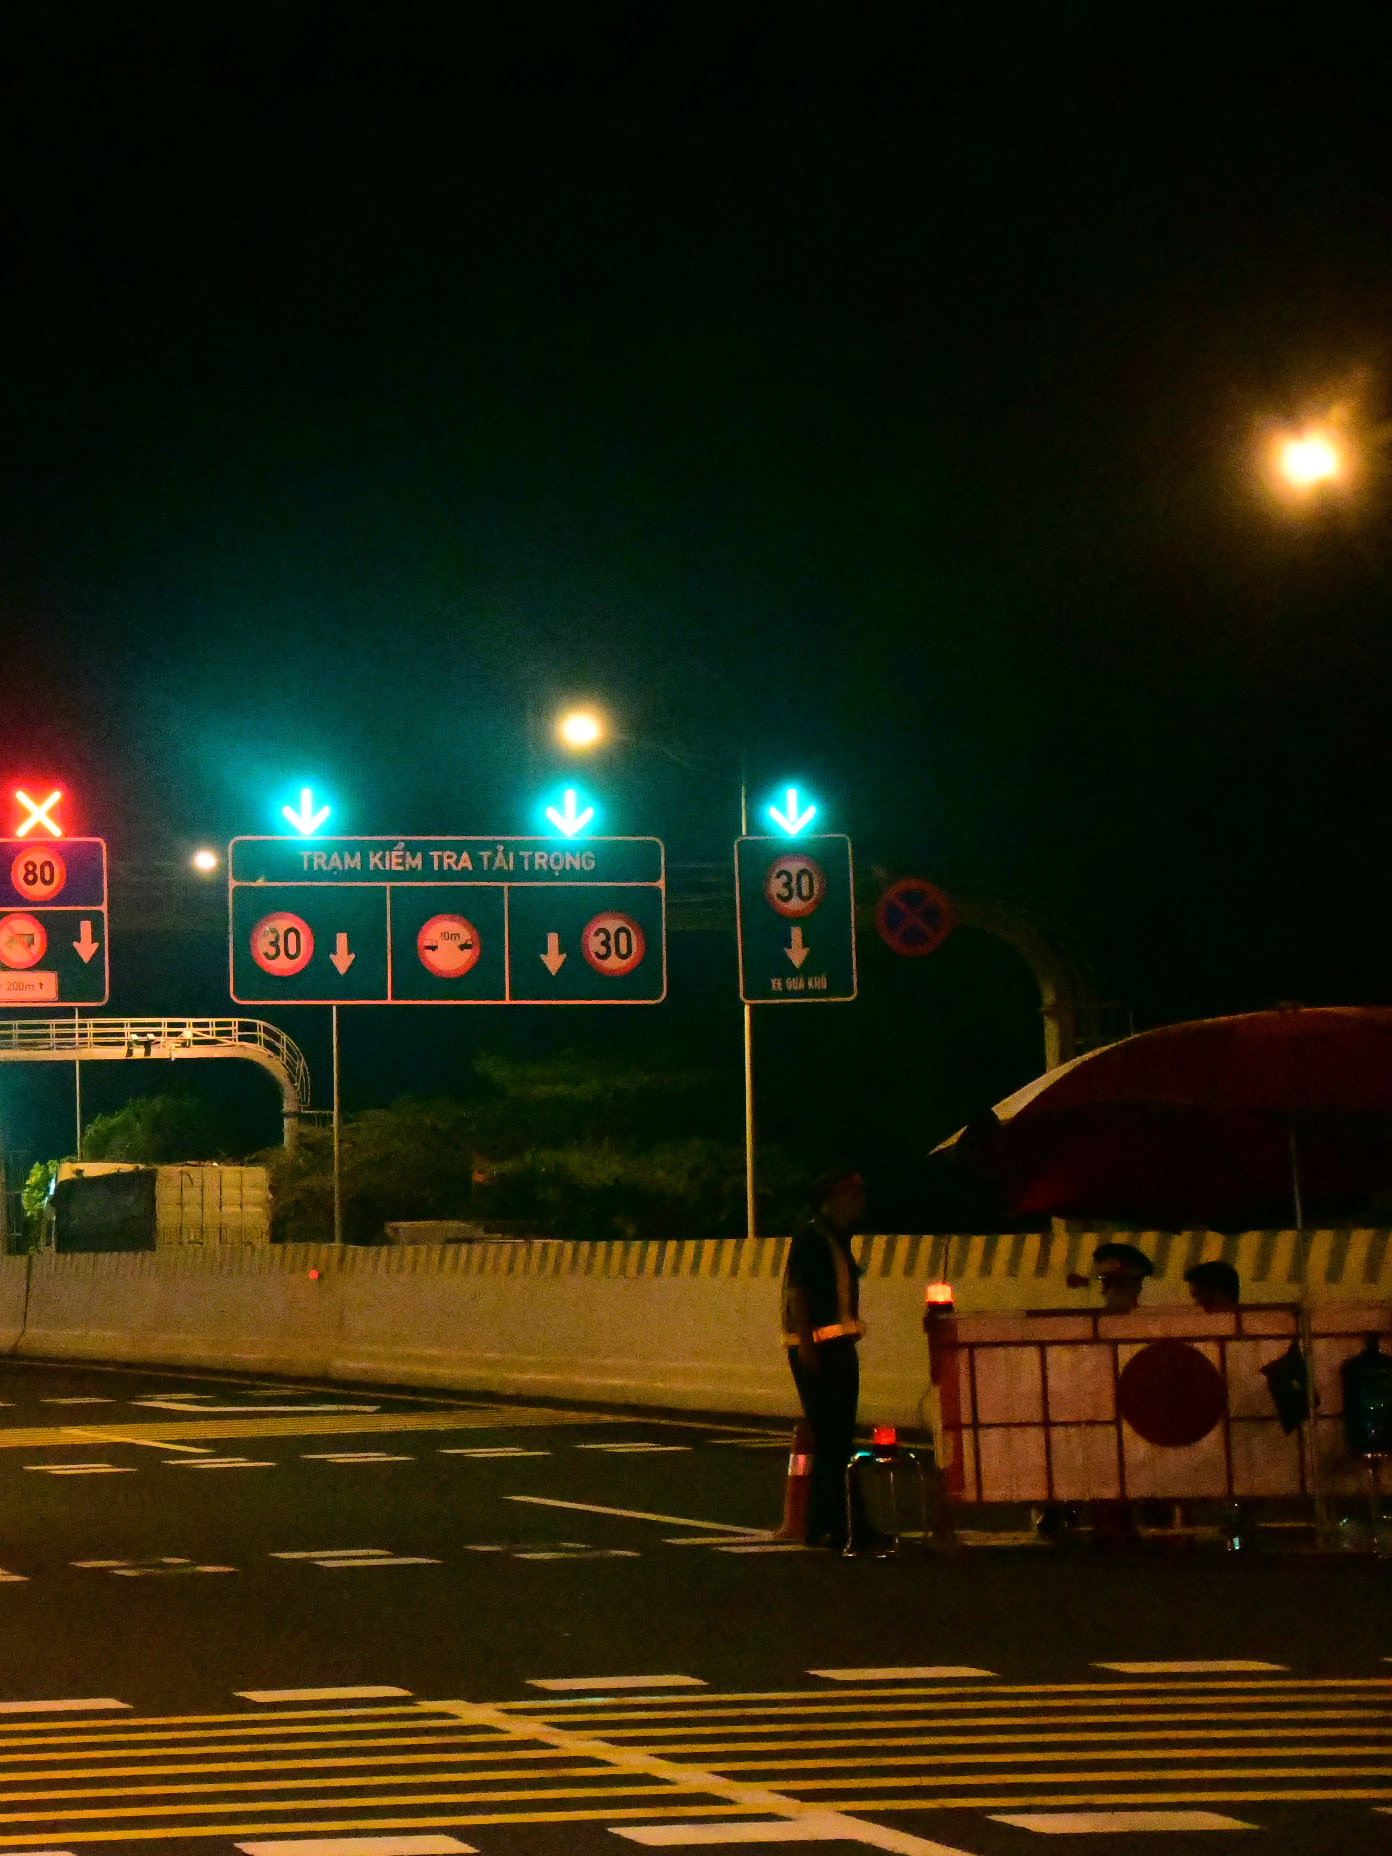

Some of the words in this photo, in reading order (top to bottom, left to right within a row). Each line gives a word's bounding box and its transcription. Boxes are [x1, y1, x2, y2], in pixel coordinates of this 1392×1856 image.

[22, 860, 55, 887] 80
[300, 851, 360, 875] TRẠM
[369, 842, 423, 871] KIỂM
[429, 851, 473, 871] TRA
[479, 845, 515, 871] TẢI
[520, 851, 596, 876] TRỌNG
[776, 868, 815, 903] 30
[262, 926, 302, 961] 30
[592, 926, 634, 961] 30
[6, 981, 35, 992] 200m
